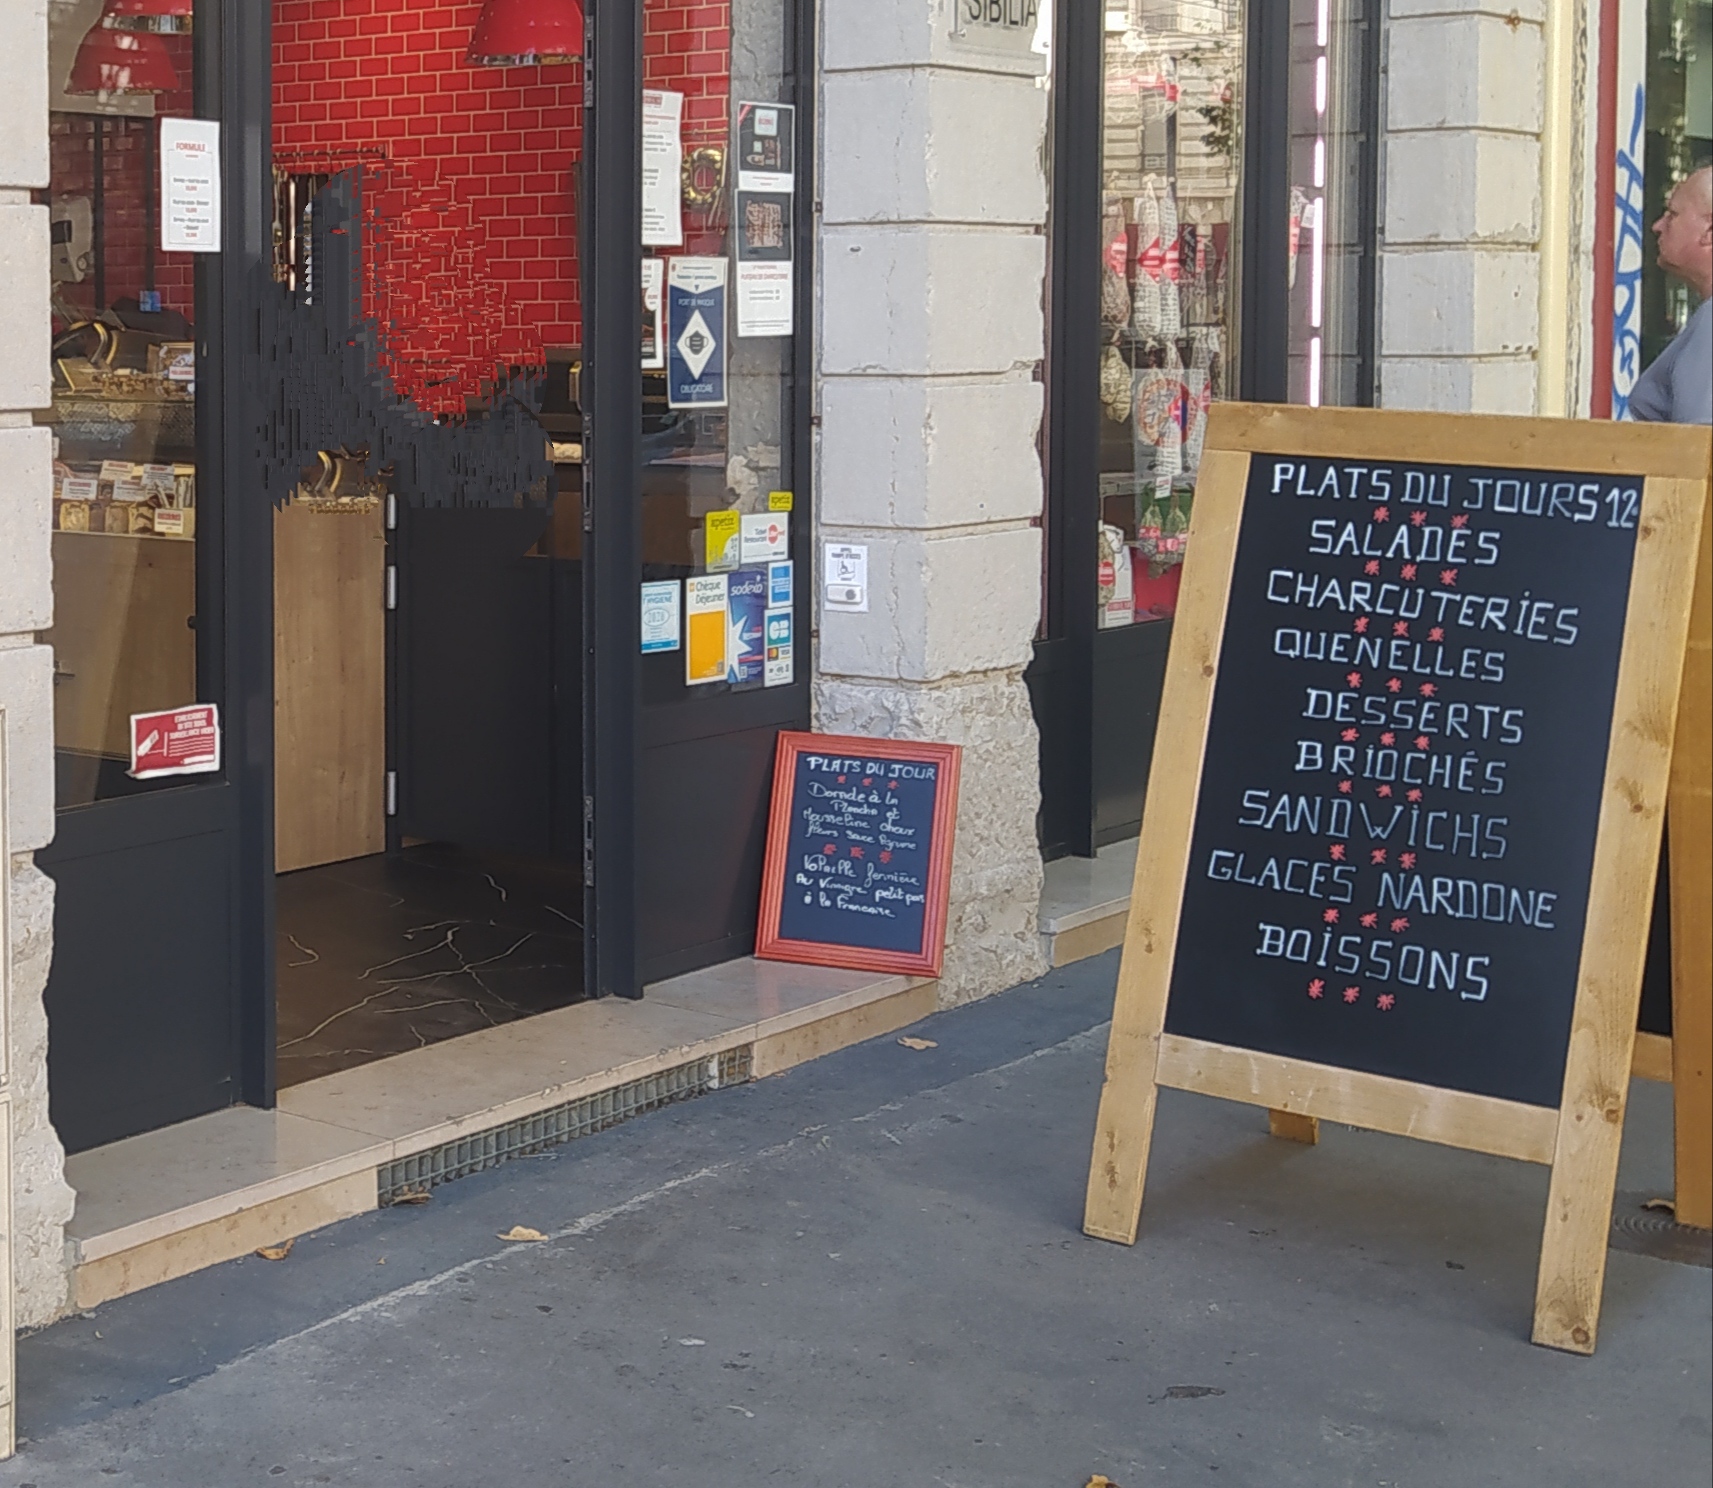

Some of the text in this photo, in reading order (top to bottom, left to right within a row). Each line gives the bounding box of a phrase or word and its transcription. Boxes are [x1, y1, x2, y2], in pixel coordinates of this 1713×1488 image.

[1271, 463, 1393, 502] PLATS
[1400, 471, 1451, 507] DU
[1462, 477, 1600, 523] JOURS
[1308, 519, 1501, 565] SALADES
[730, 578, 763, 596] sodexo
[1266, 568, 1580, 645] CHARCUTERIES
[769, 619, 789, 640] CB
[1273, 628, 1506, 682] QUENELLES
[1302, 687, 1524, 744] DESSERTS
[806, 756, 936, 781] PLATS DU JOUR
[1238, 789, 1509, 860] SANDWICHS
[1207, 849, 1558, 929] GLACES NARDONE
[1256, 922, 1490, 1001] BOISSONS
